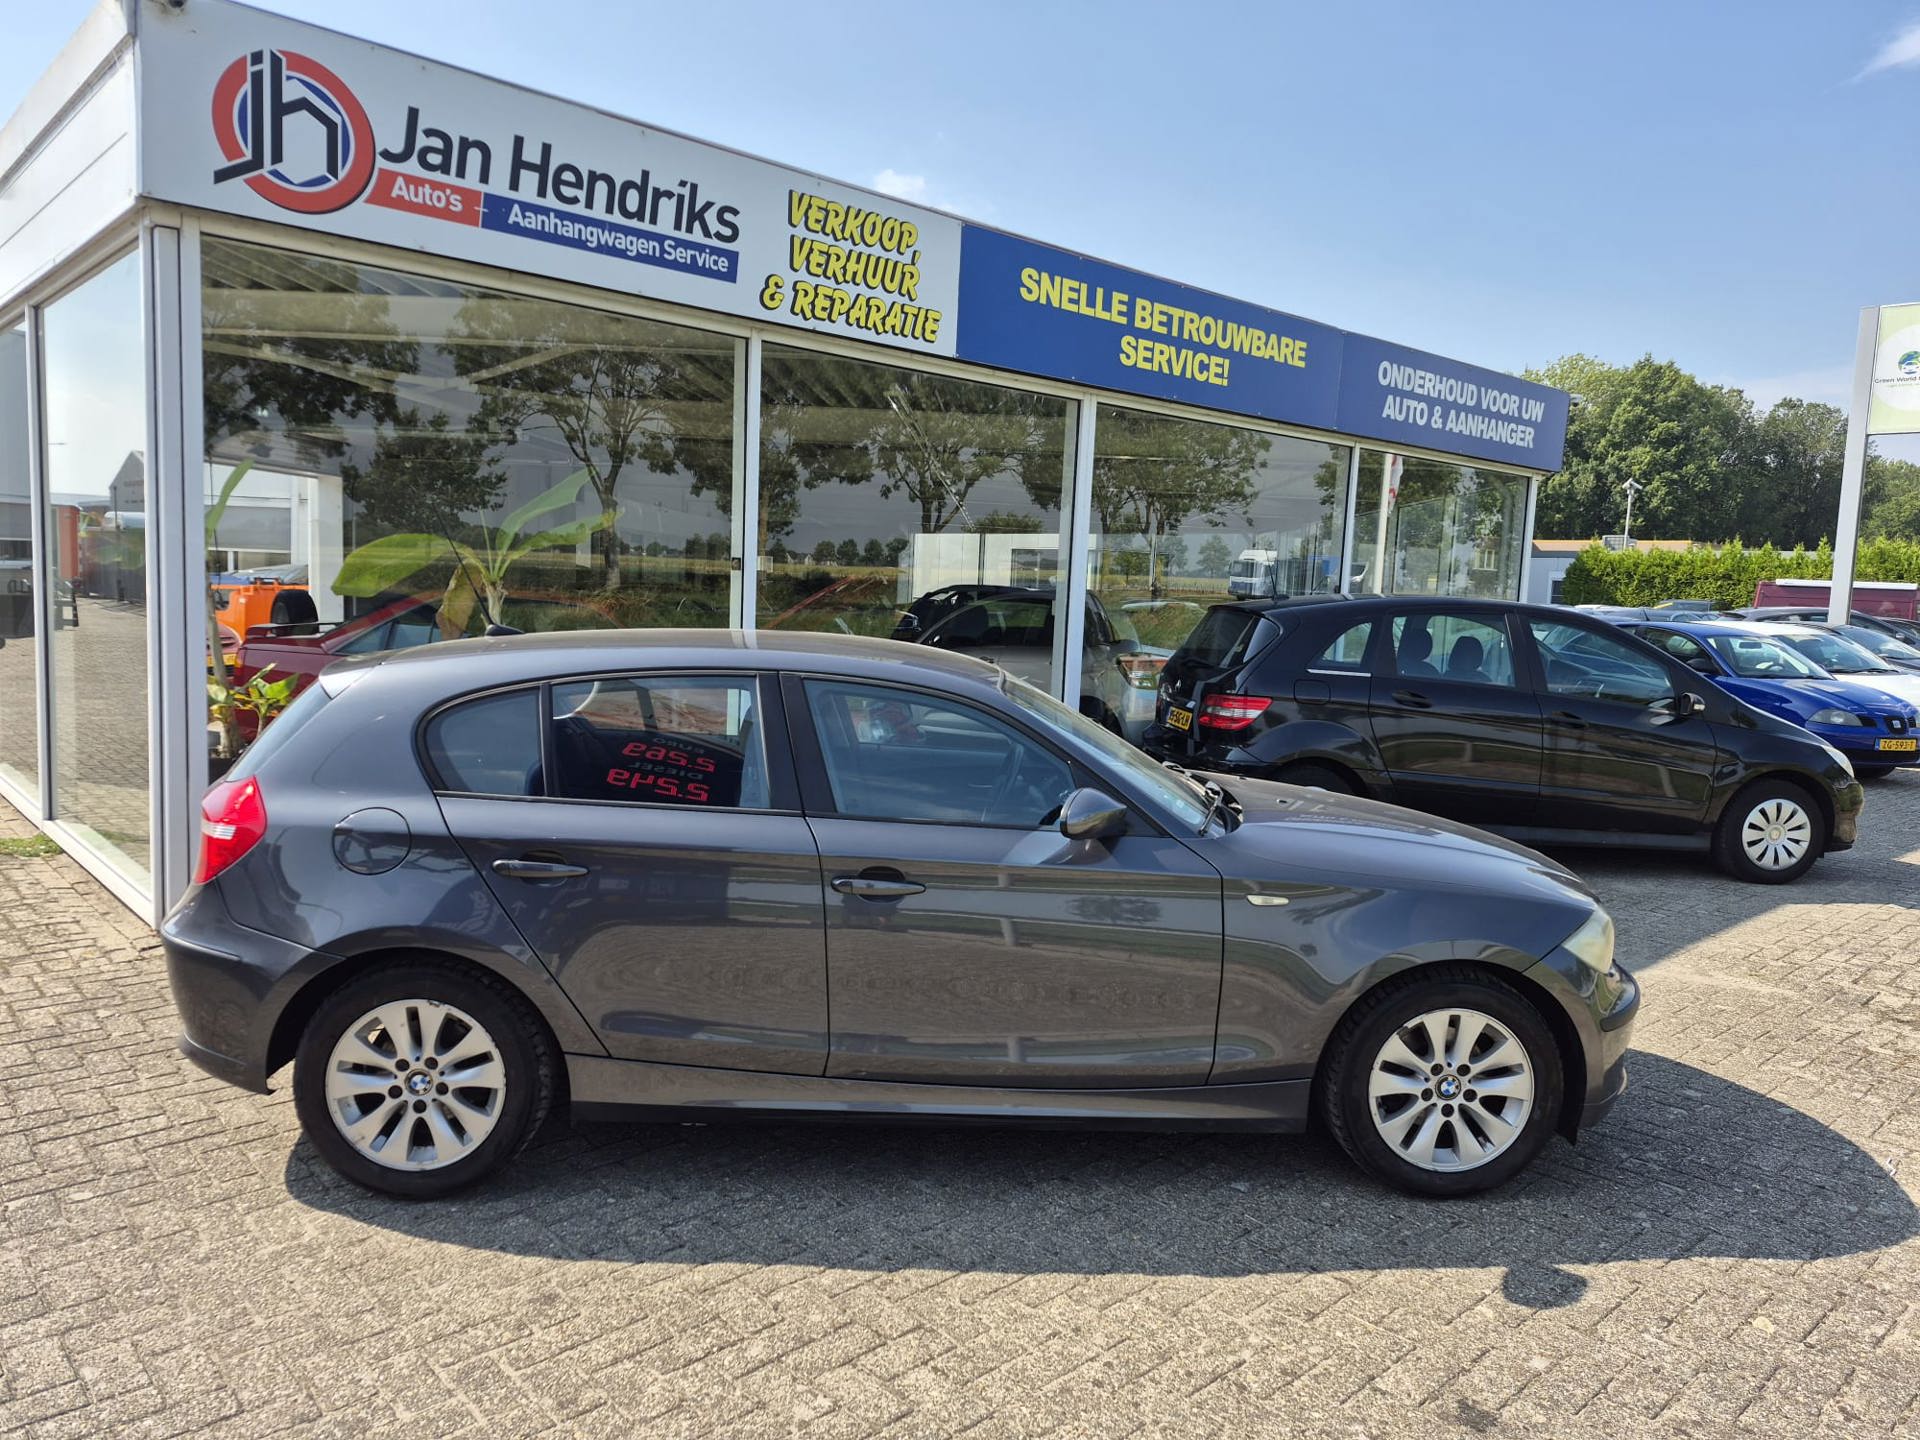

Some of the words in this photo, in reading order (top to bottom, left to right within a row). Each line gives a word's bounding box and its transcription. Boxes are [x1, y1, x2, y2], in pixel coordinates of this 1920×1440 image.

[378, 105, 492, 186] Jan
[508, 134, 741, 244] Hendriks
[391, 176, 464, 212] Auto's
[507, 203, 661, 257] Aanhangwagen
[663, 240, 729, 273] Service
[788, 189, 921, 265] VERKOOP,
[790, 234, 921, 302] VERHUUR
[759, 273, 786, 311] &
[791, 280, 943, 343] REPARATIE
[1019, 267, 1129, 325] SNELLE
[1134, 297, 1308, 368] BETROUWBARE
[1119, 335, 1231, 387] SERVICE!
[1378, 360, 1478, 407] ONDERHOUD
[1481, 387, 1520, 418] VOOR
[1521, 397, 1545, 423] UW
[1382, 394, 1429, 426] AUTO
[1431, 405, 1443, 429] &
[1446, 409, 1535, 449] AANHANGER
